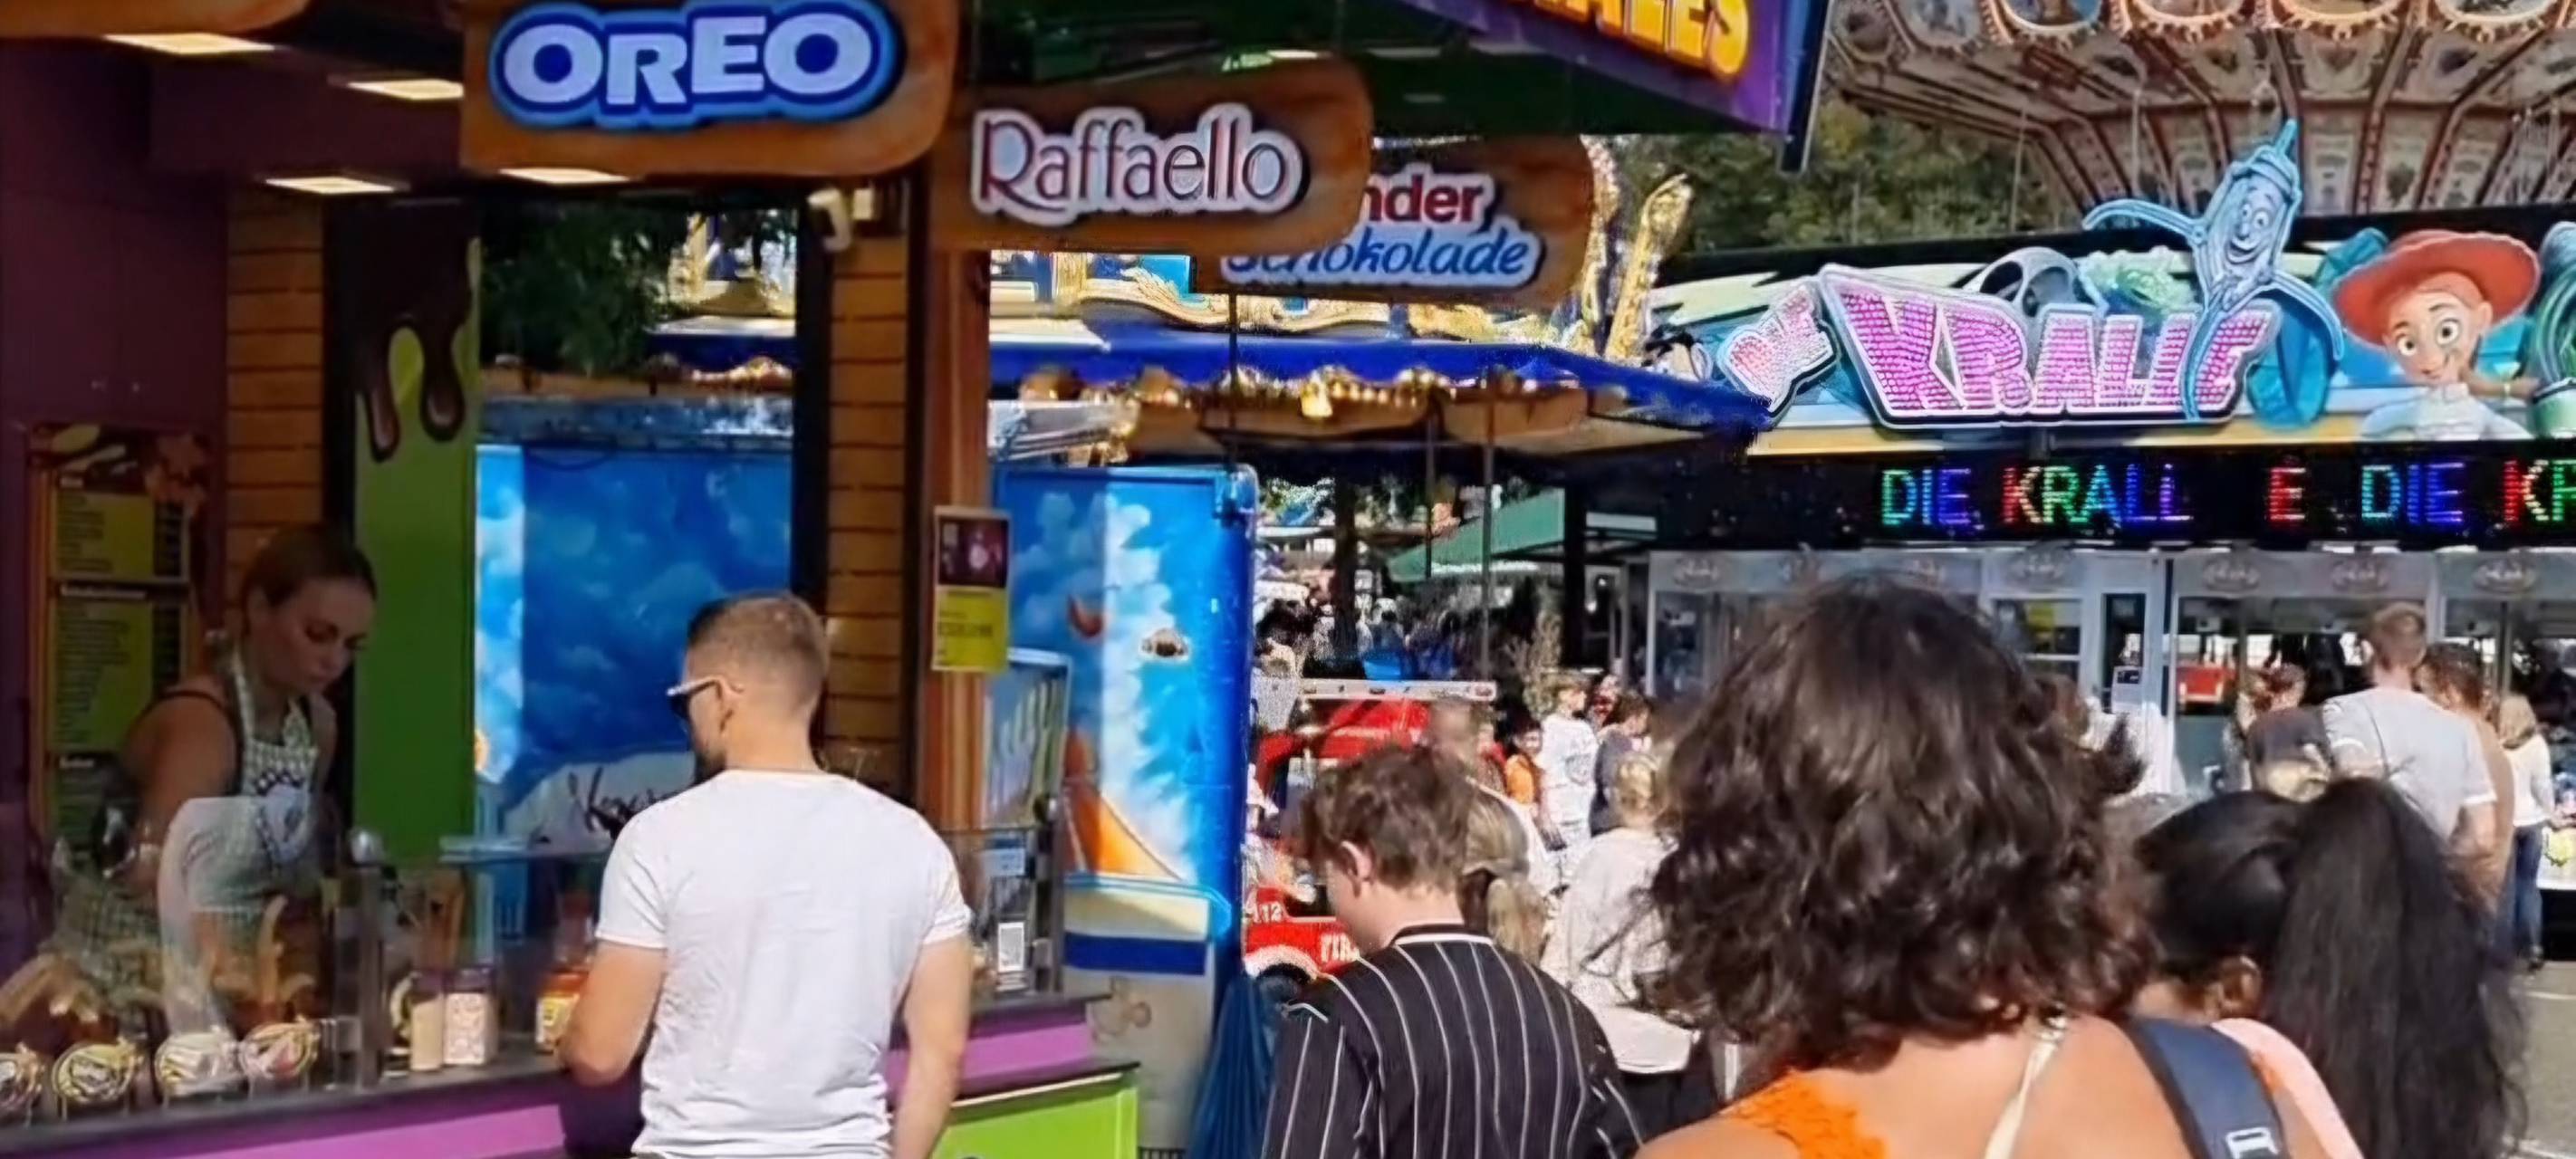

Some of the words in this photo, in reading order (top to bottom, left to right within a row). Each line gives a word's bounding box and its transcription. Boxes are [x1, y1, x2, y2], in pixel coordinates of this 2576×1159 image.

[504, 13, 871, 104] OREO
[981, 117, 1286, 212] Raffaello
[1365, 175, 1485, 223] nder
[1882, 468, 1973, 525] DIE
[2361, 462, 2465, 523] DIE
